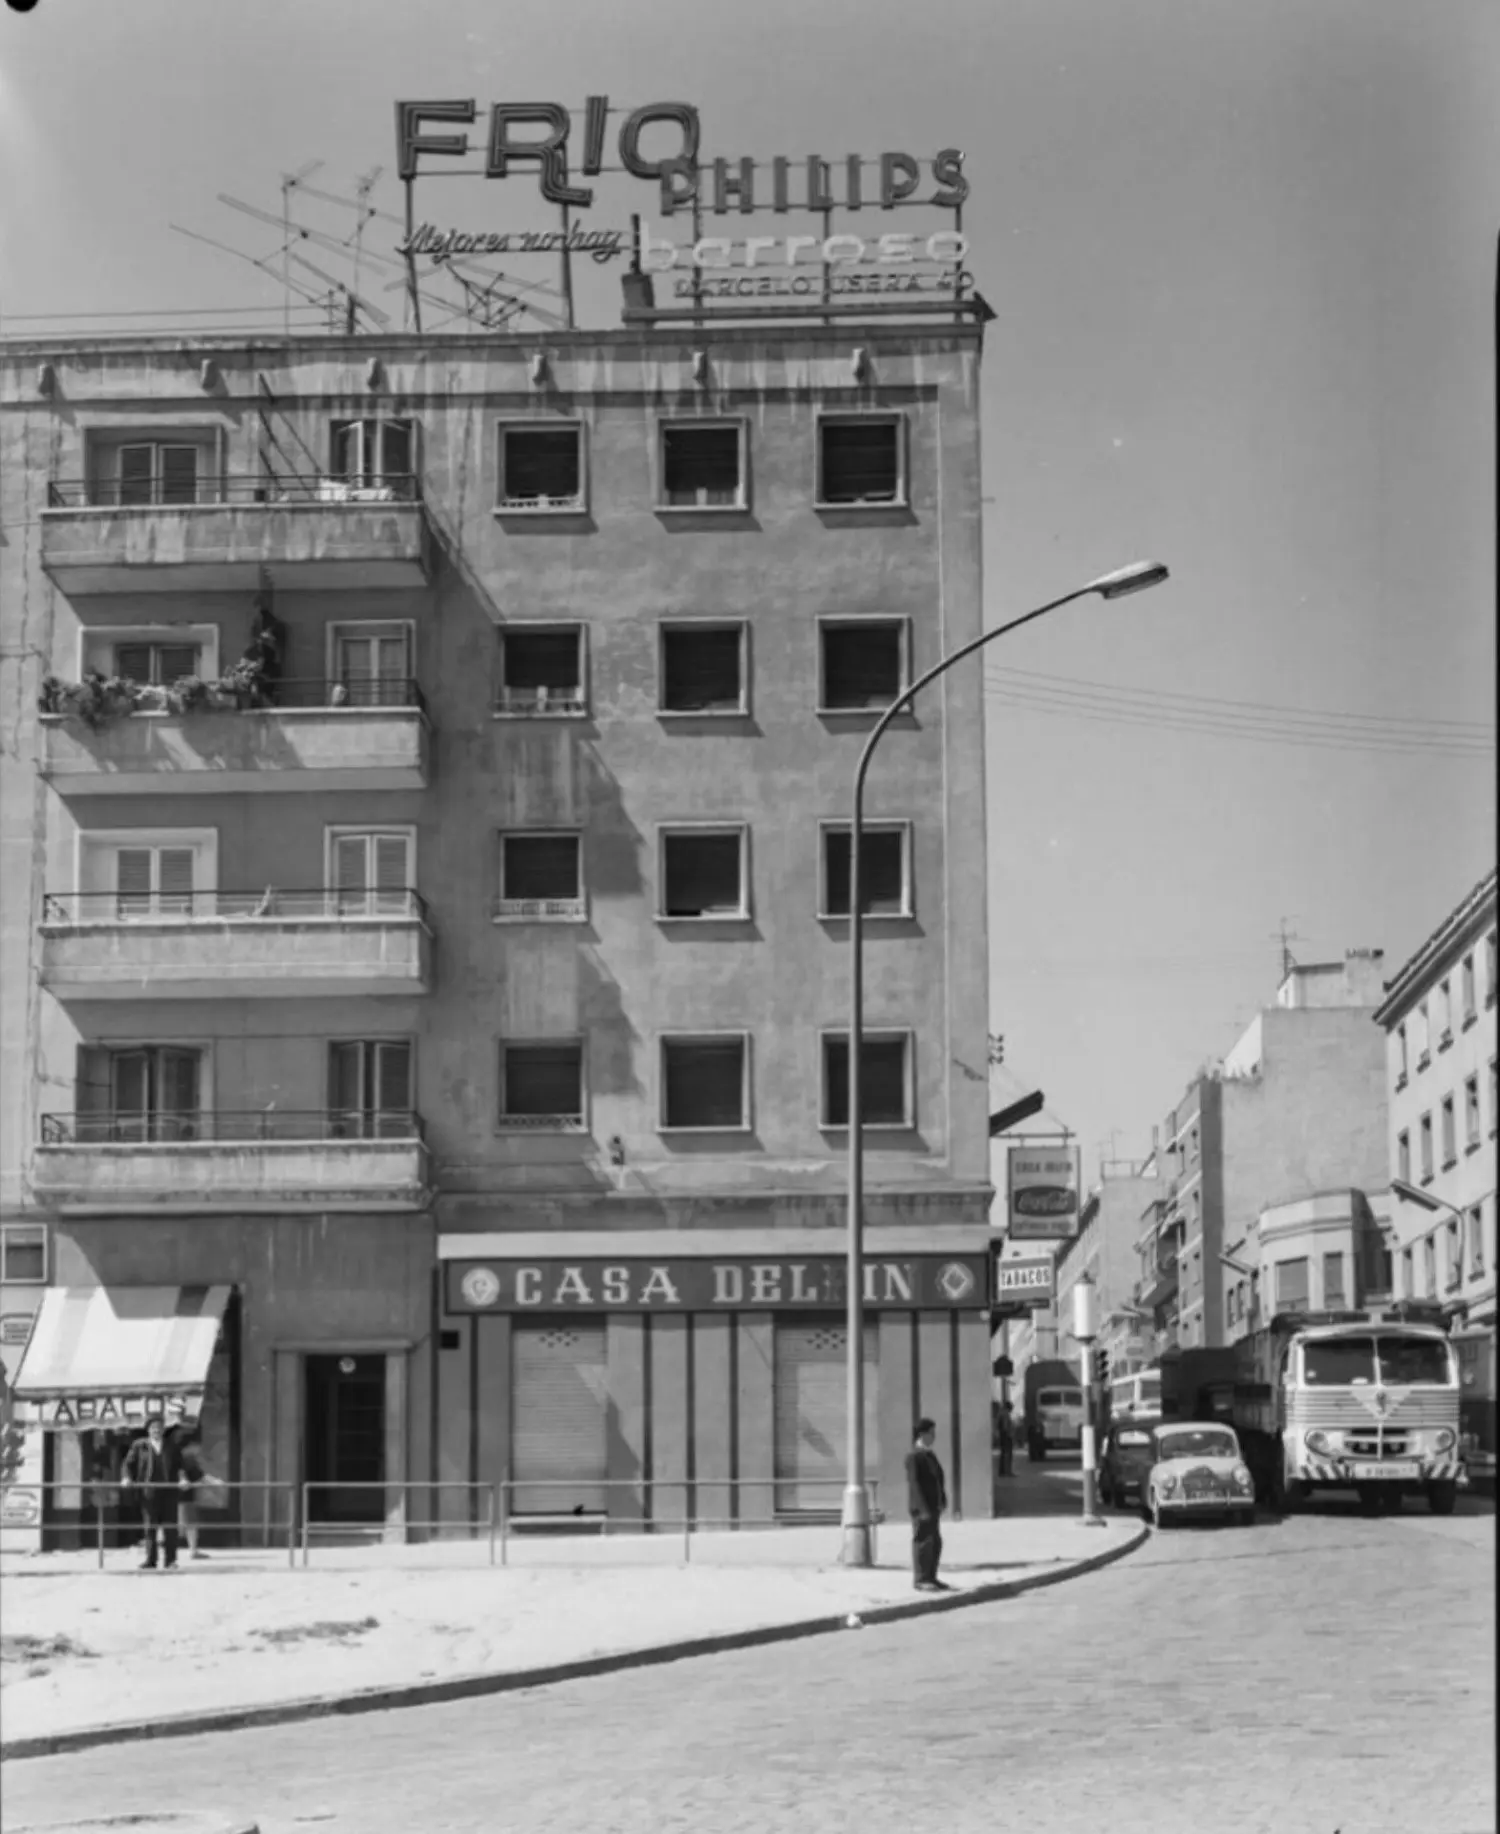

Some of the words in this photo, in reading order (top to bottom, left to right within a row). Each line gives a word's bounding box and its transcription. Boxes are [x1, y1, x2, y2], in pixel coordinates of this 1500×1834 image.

[395, 95, 700, 208] FRIO
[660, 148, 970, 217] PHILIPS
[567, 218, 623, 264] hay
[638, 218, 969, 271] barroso
[515, 1265, 681, 1305] CASA
